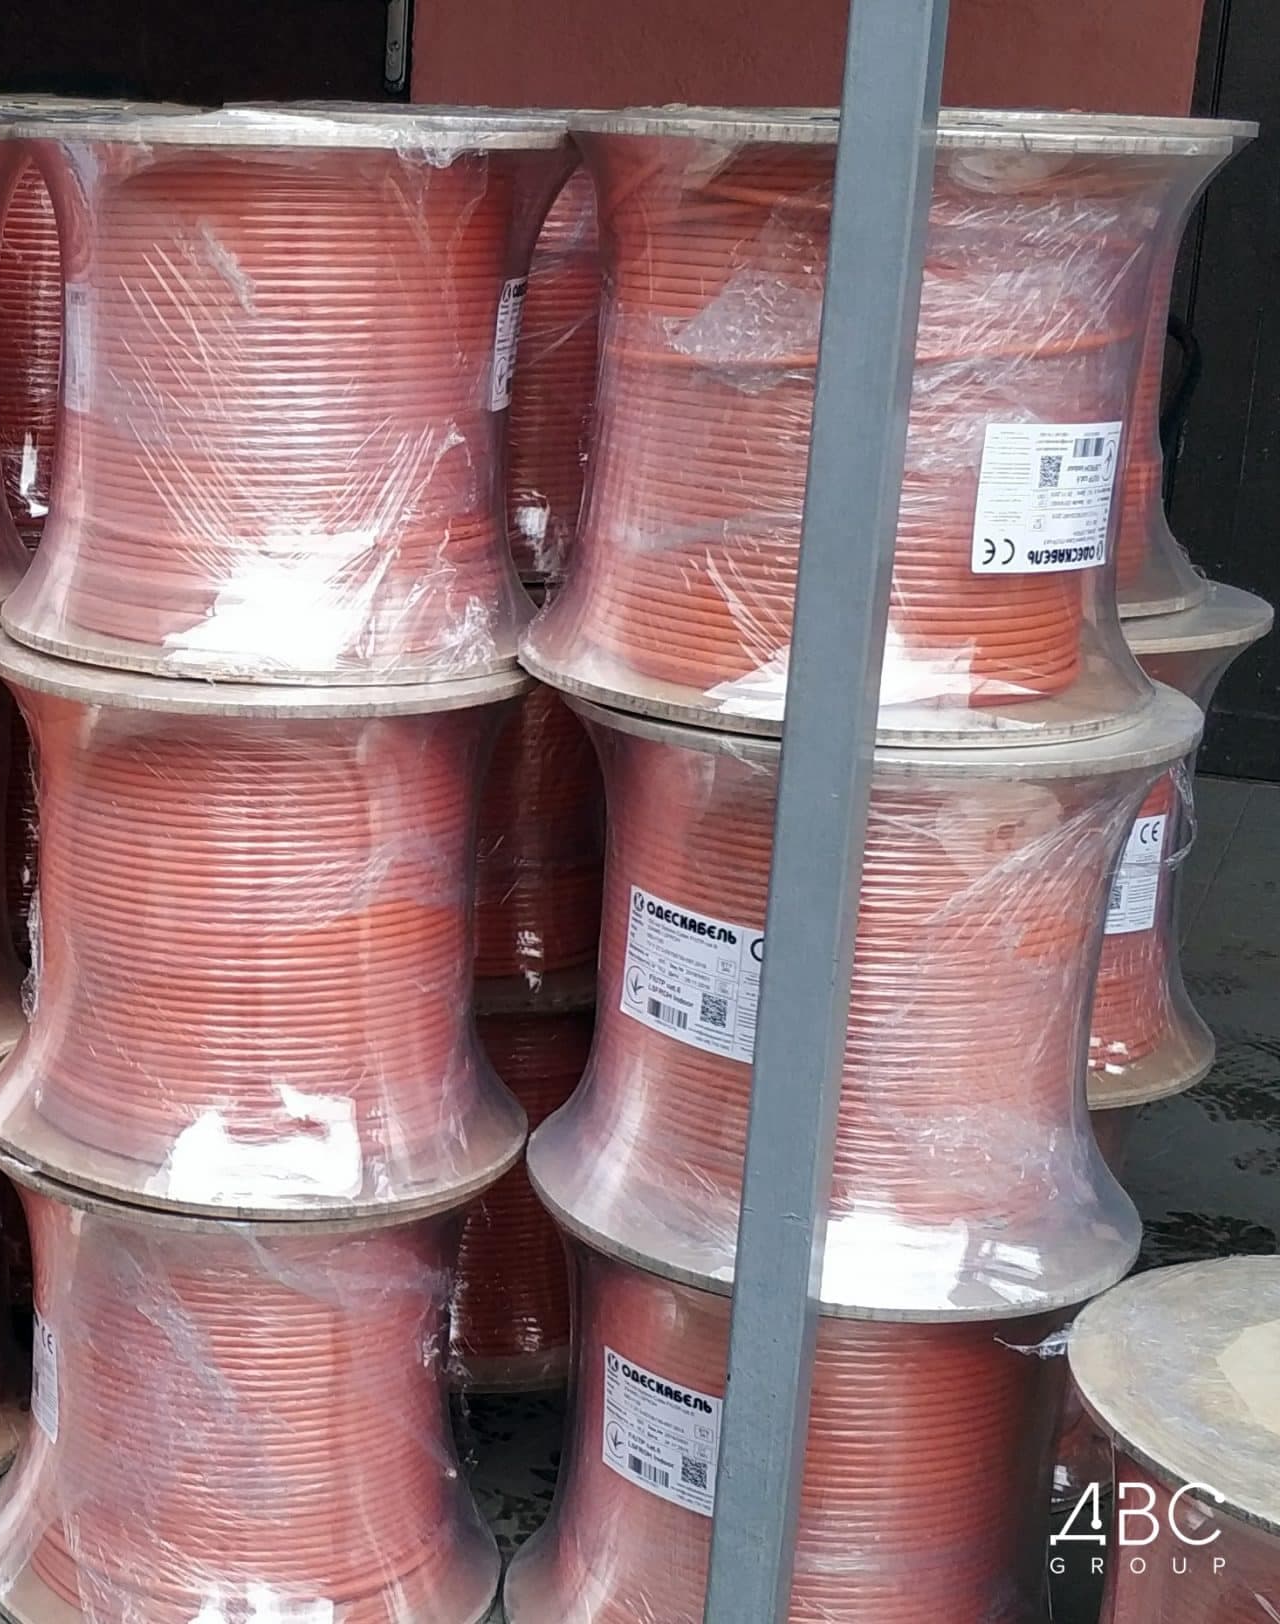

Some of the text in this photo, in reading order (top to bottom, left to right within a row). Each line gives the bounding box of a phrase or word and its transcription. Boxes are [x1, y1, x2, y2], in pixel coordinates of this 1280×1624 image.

[981, 538, 1015, 566] CE
[1026, 545, 1095, 565] ОДЕСКАБЕЛЬ
[1140, 821, 1160, 844] CE
[646, 901, 737, 944] ОДЕСКАБЕЛЬ
[750, 938, 765, 962] C
[621, 1364, 713, 1414] ОДЕСКАБЕЛЬ
